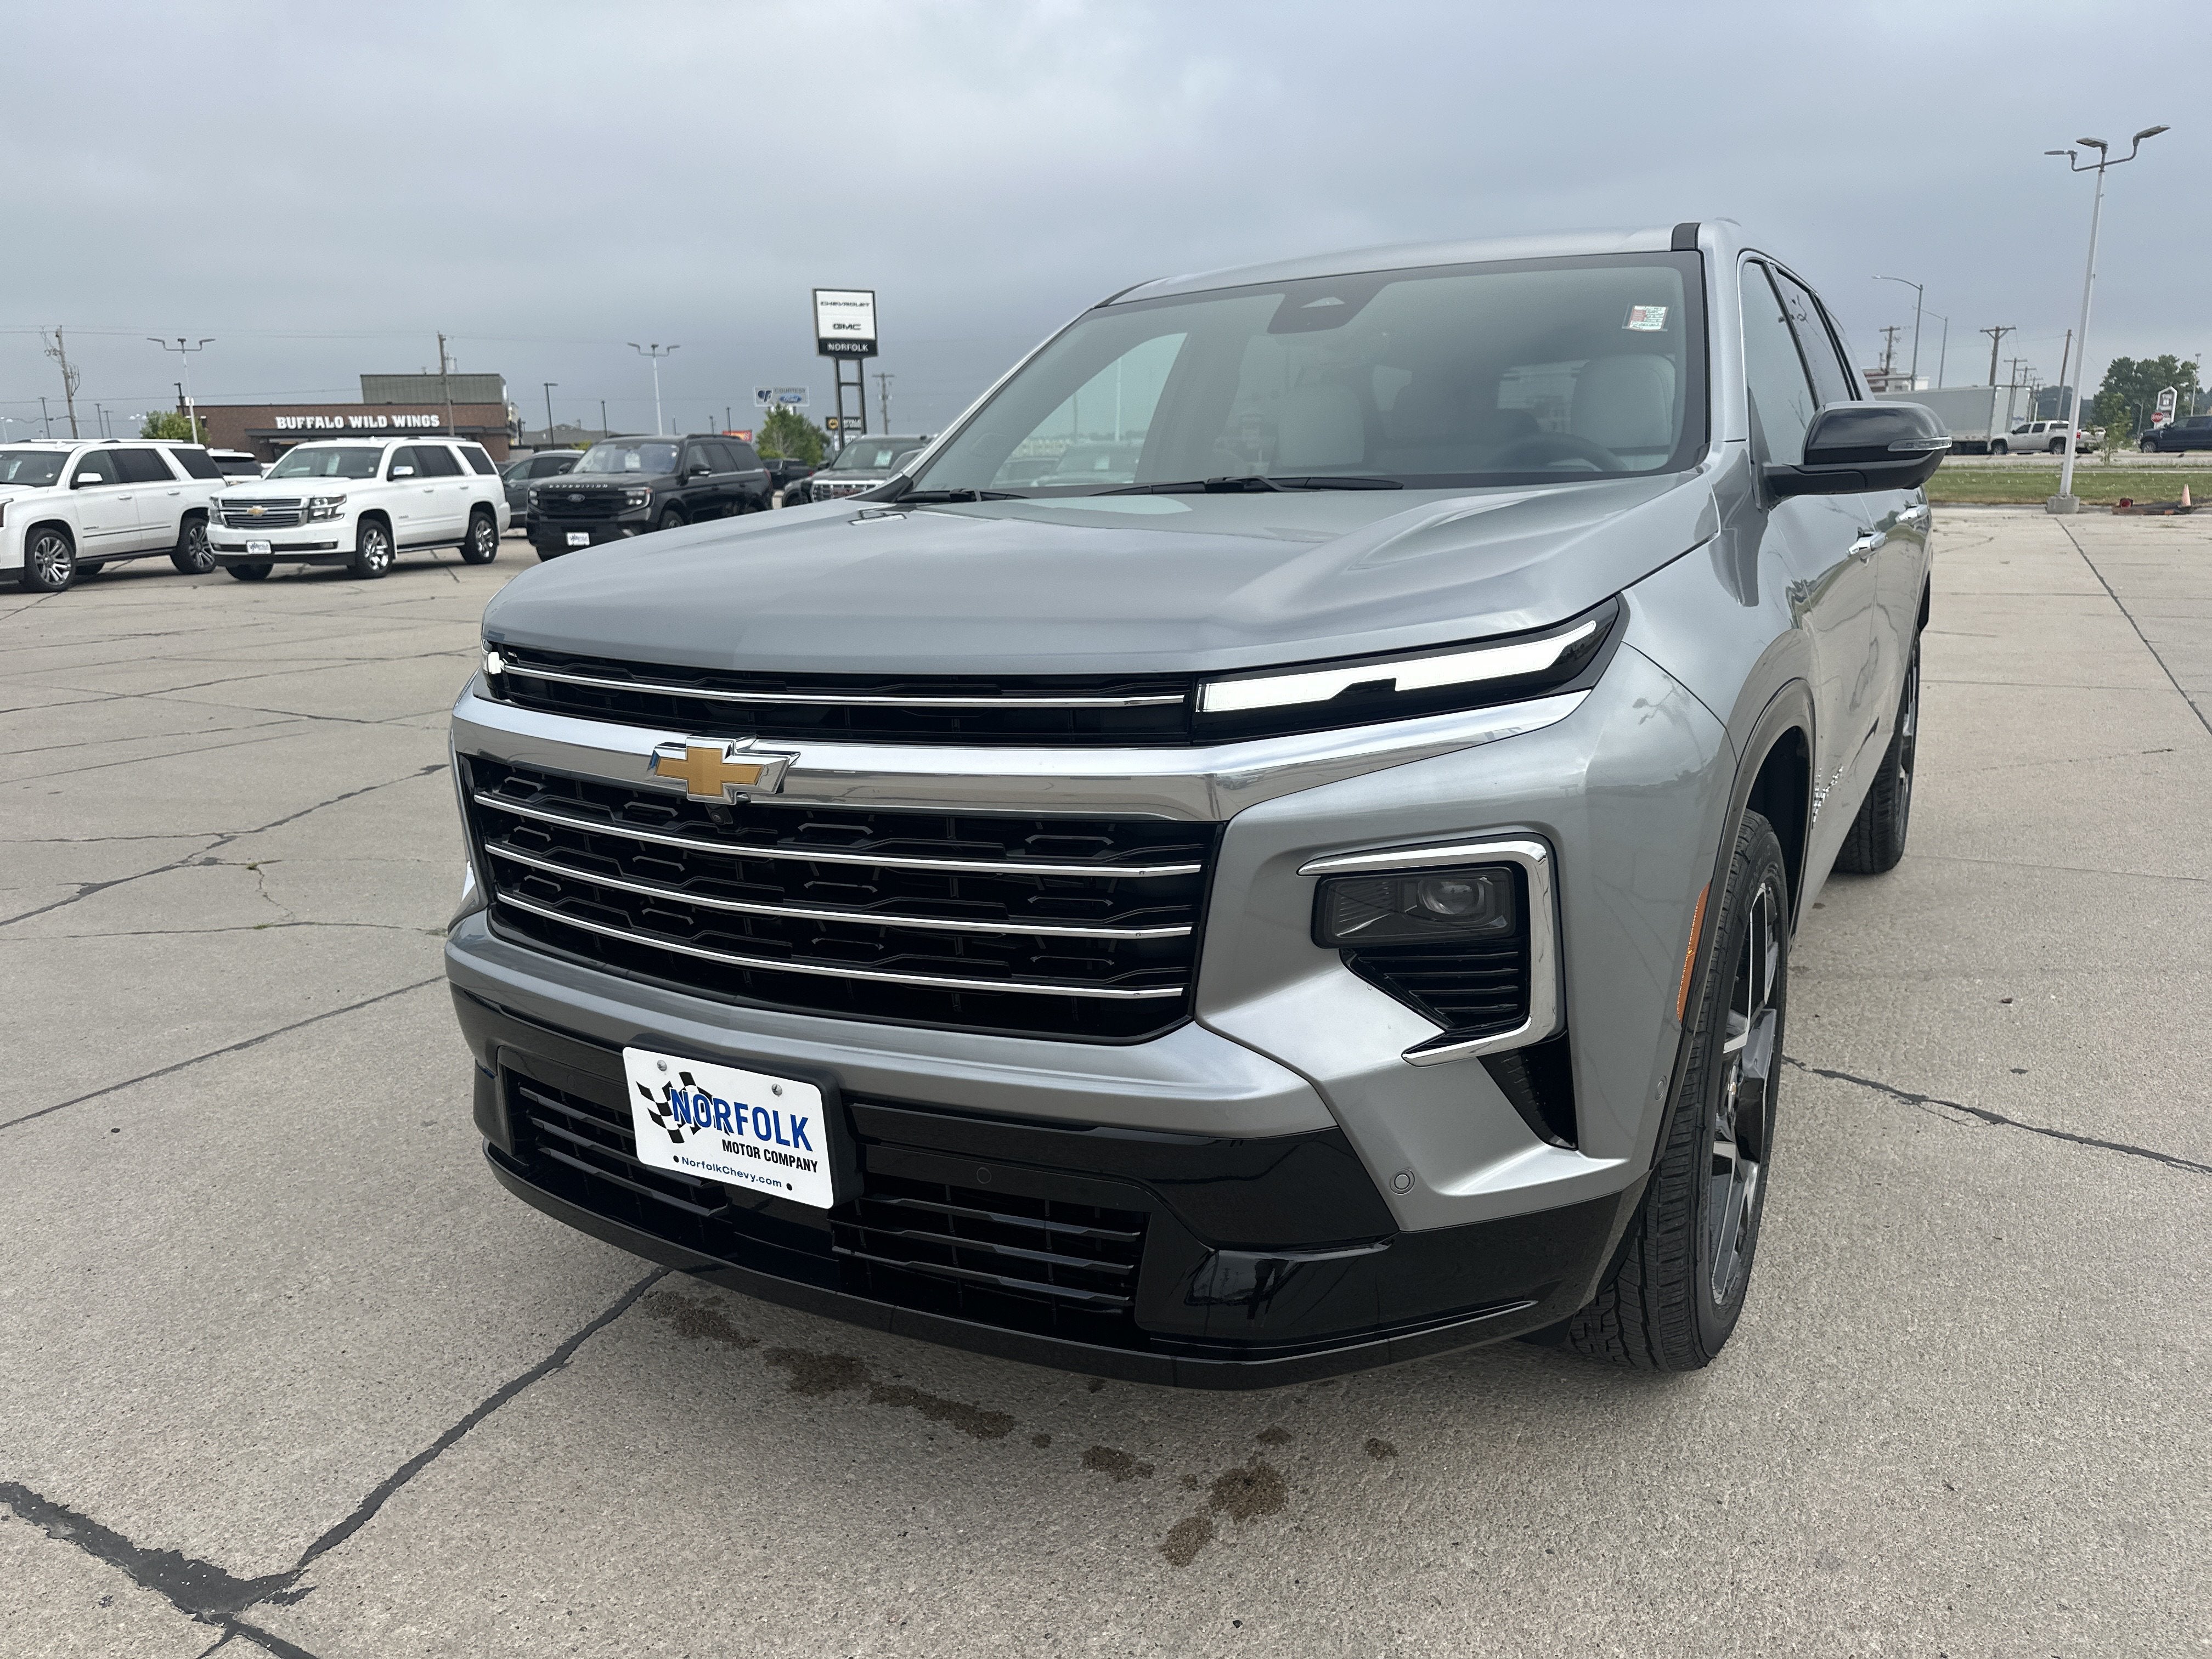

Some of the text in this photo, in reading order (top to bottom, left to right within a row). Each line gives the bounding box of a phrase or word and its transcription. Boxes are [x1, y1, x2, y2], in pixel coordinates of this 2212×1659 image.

[827, 342, 868, 352] NORFOLK
[275, 414, 440, 430] BUFFALO WILD WINGS
[670, 1088, 814, 1152] NORFOLK
[681, 1156, 782, 1188] NorfolkChevy.com
[721, 1139, 818, 1173] MOTOR COMPANY
